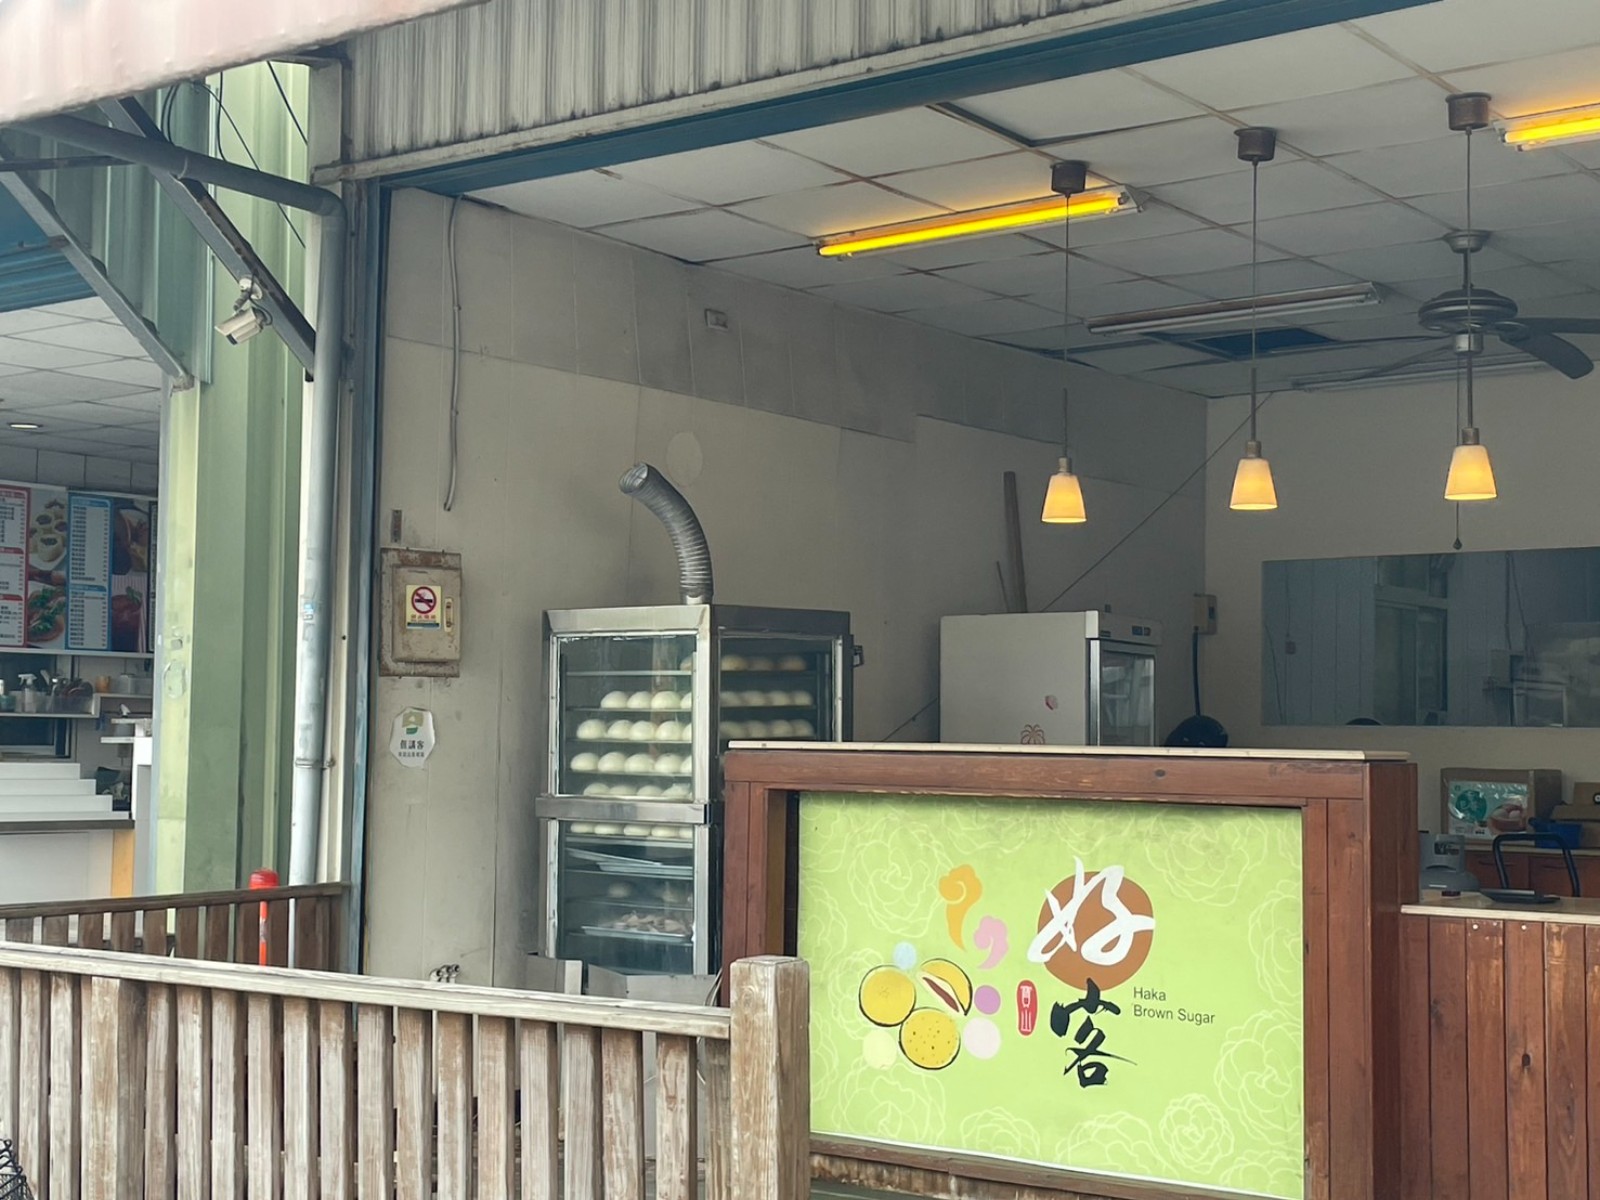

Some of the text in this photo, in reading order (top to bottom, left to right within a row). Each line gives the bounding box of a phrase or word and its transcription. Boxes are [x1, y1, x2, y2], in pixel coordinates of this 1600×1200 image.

[1027, 855, 1156, 1088] 好客
[1133, 986, 1167, 1001] Haka
[1133, 1004, 1215, 1026] Brown Sugar
